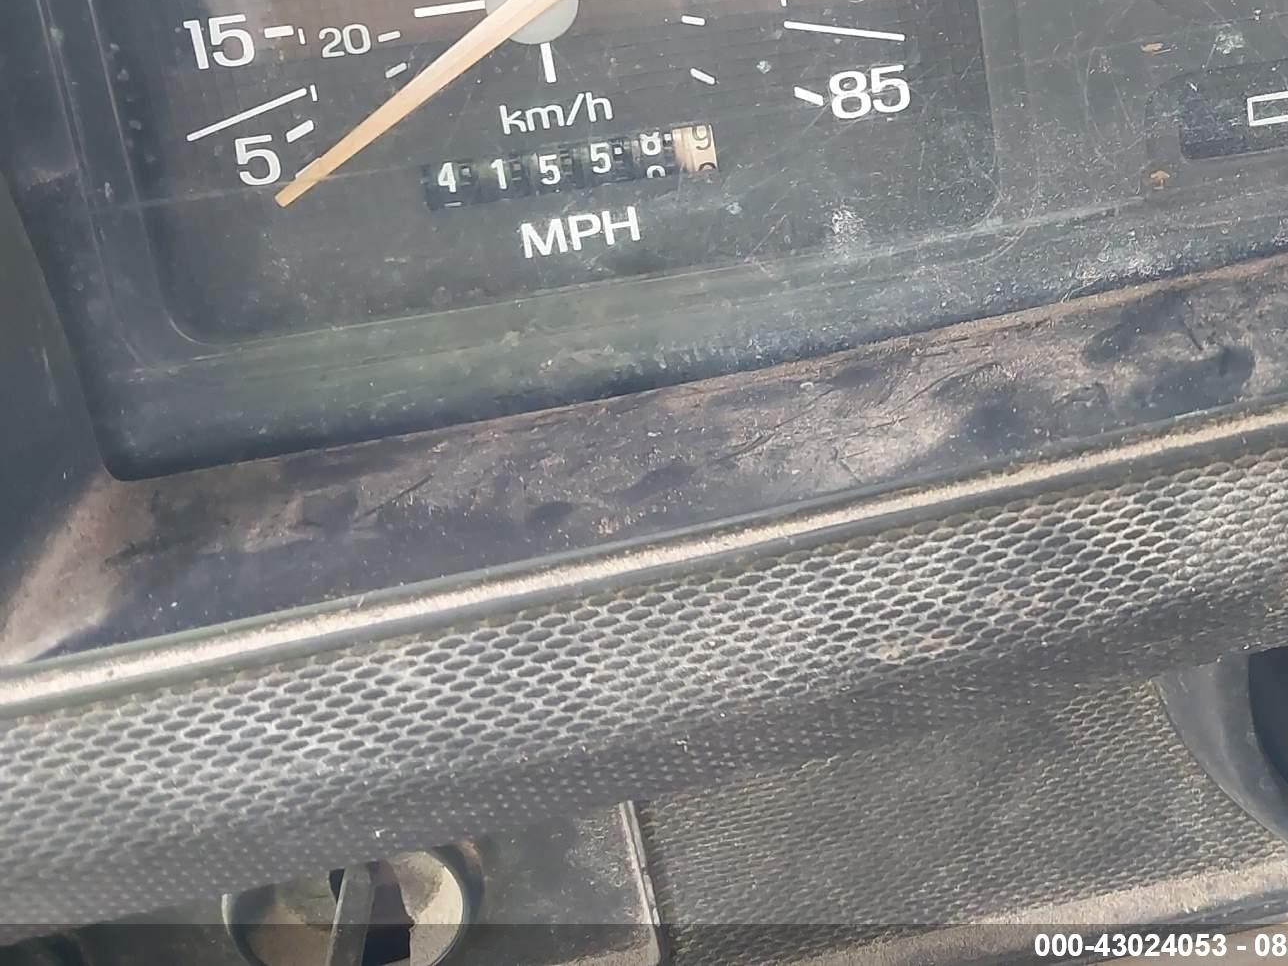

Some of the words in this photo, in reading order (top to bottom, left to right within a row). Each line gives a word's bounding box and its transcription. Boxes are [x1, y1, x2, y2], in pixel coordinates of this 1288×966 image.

[182, 14, 256, 70] 15
[318, 23, 372, 58] 20
[499, 91, 614, 135] km/h
[829, 64, 911, 119] 85
[234, 134, 282, 186] 5
[520, 206, 641, 259] MPH
